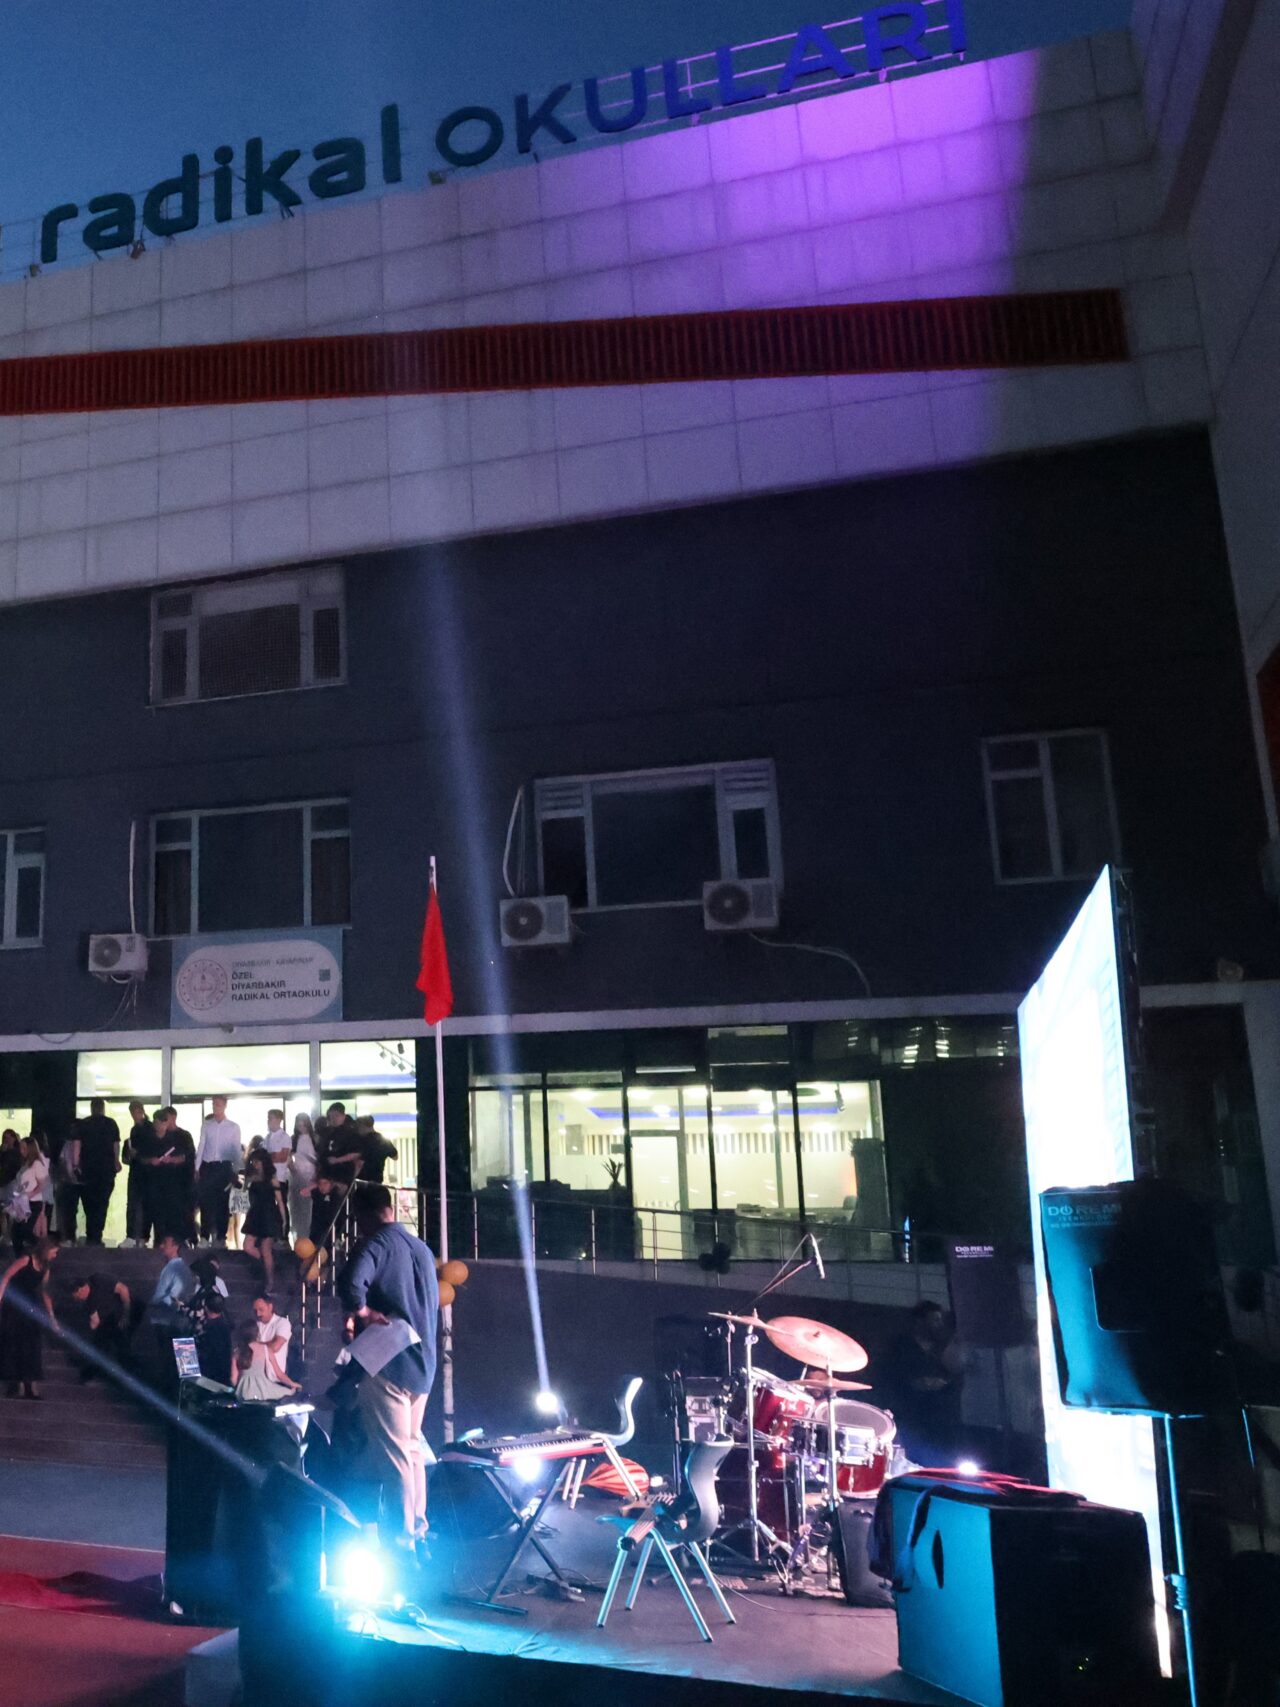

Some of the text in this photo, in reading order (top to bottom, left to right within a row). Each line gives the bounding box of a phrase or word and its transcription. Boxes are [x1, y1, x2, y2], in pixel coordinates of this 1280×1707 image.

[40, 0, 967, 264] radikal OKULLARI
[273, 989, 330, 999] ORTAOKULU
